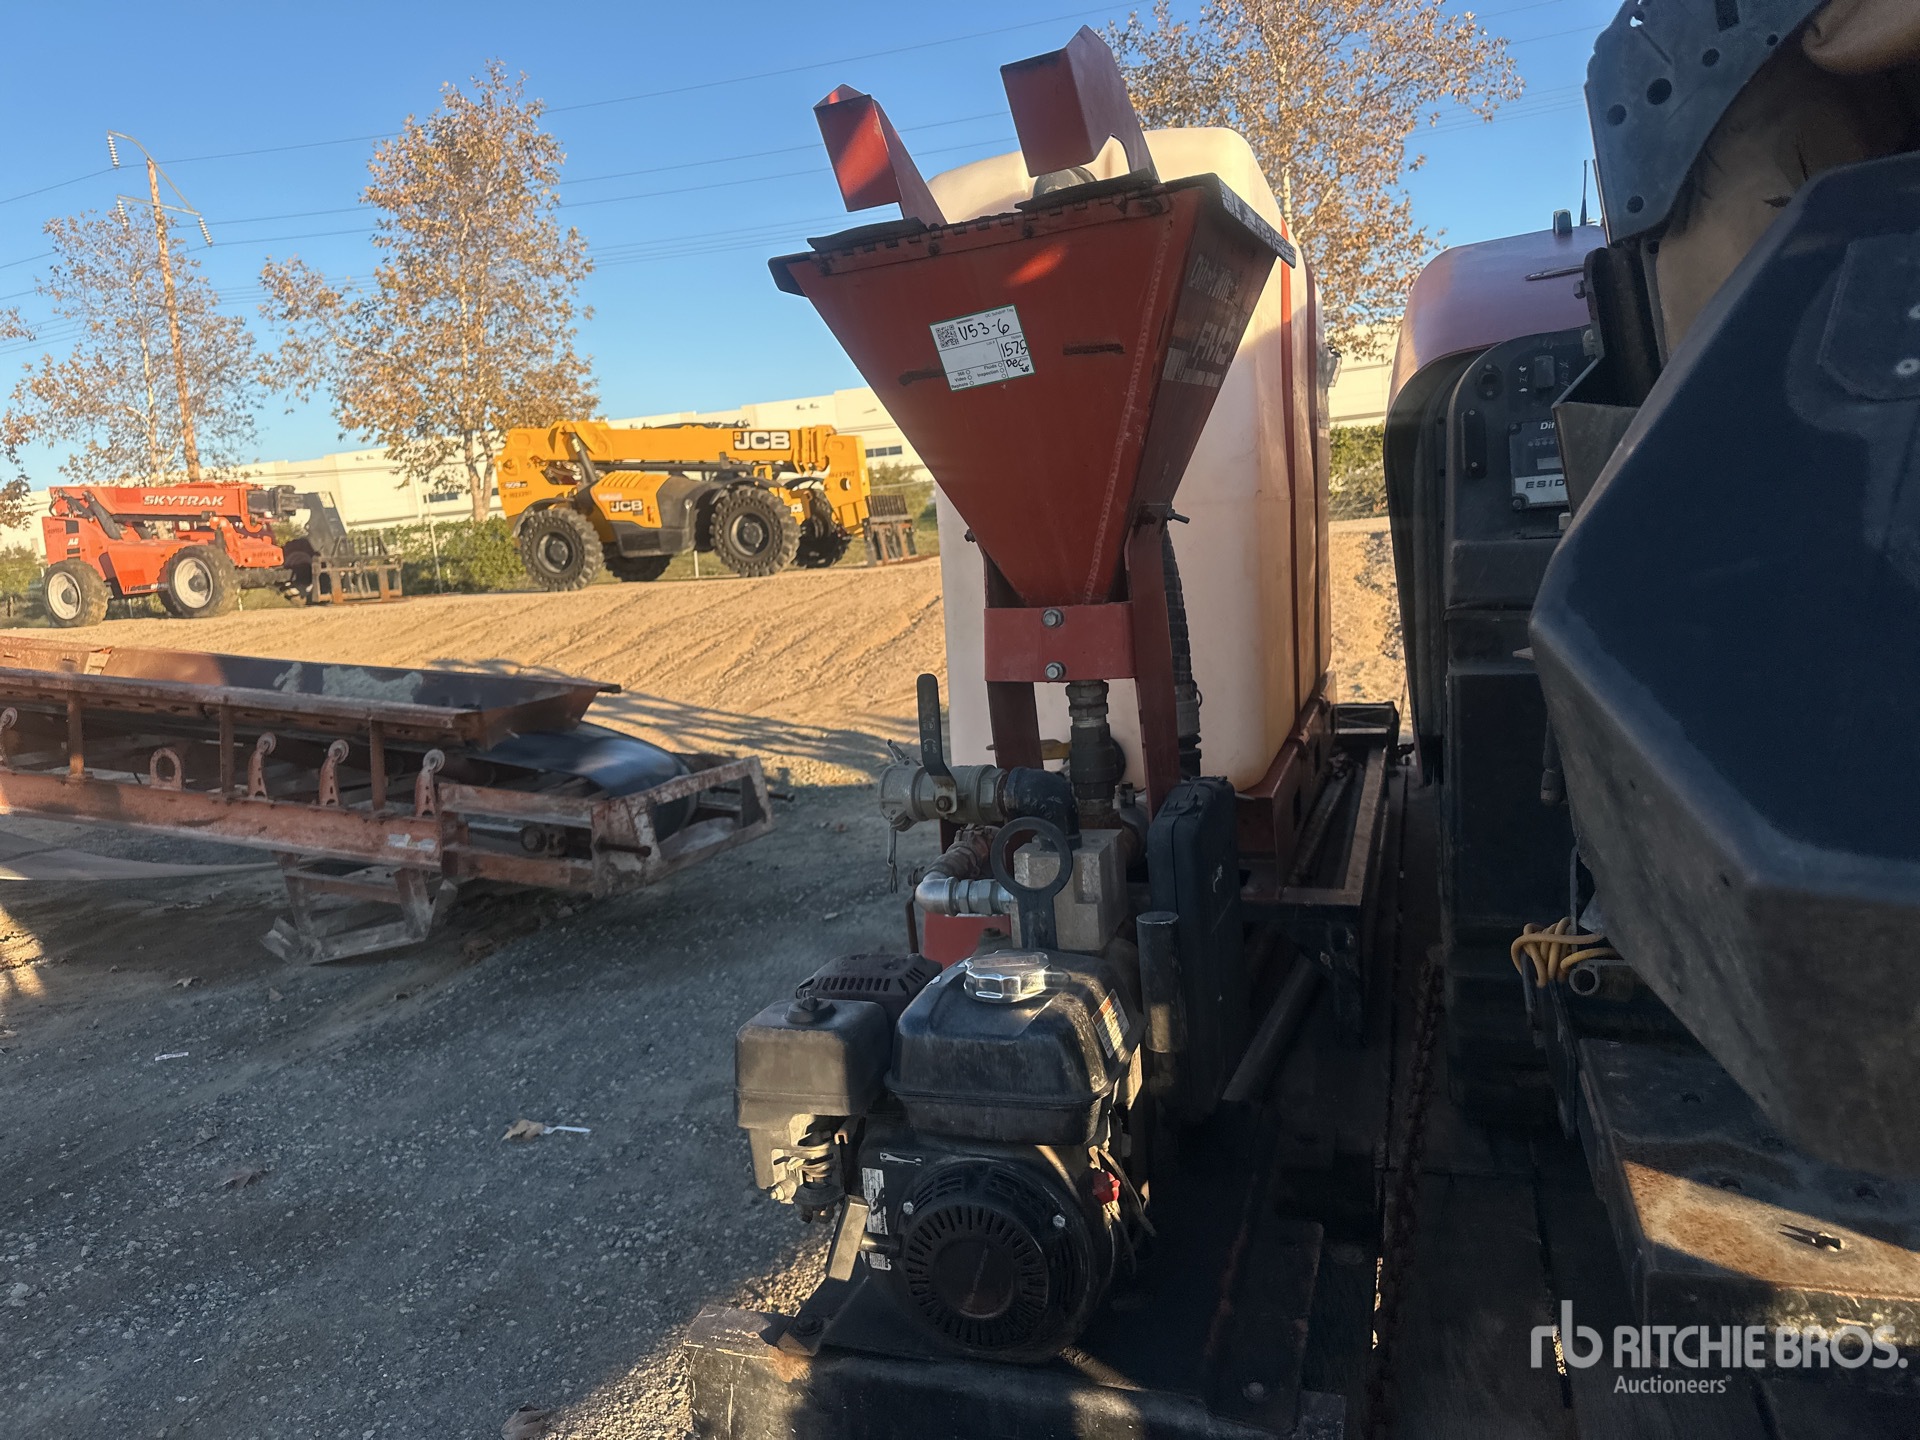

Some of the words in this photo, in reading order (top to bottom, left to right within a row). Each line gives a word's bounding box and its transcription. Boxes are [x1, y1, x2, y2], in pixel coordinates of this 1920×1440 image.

[1000, 339, 1028, 358] 1575
[1006, 358, 1024, 368] Dec
[733, 431, 790, 450] JCB
[143, 495, 226, 506] SKYTRAK
[610, 500, 643, 512] JCB
